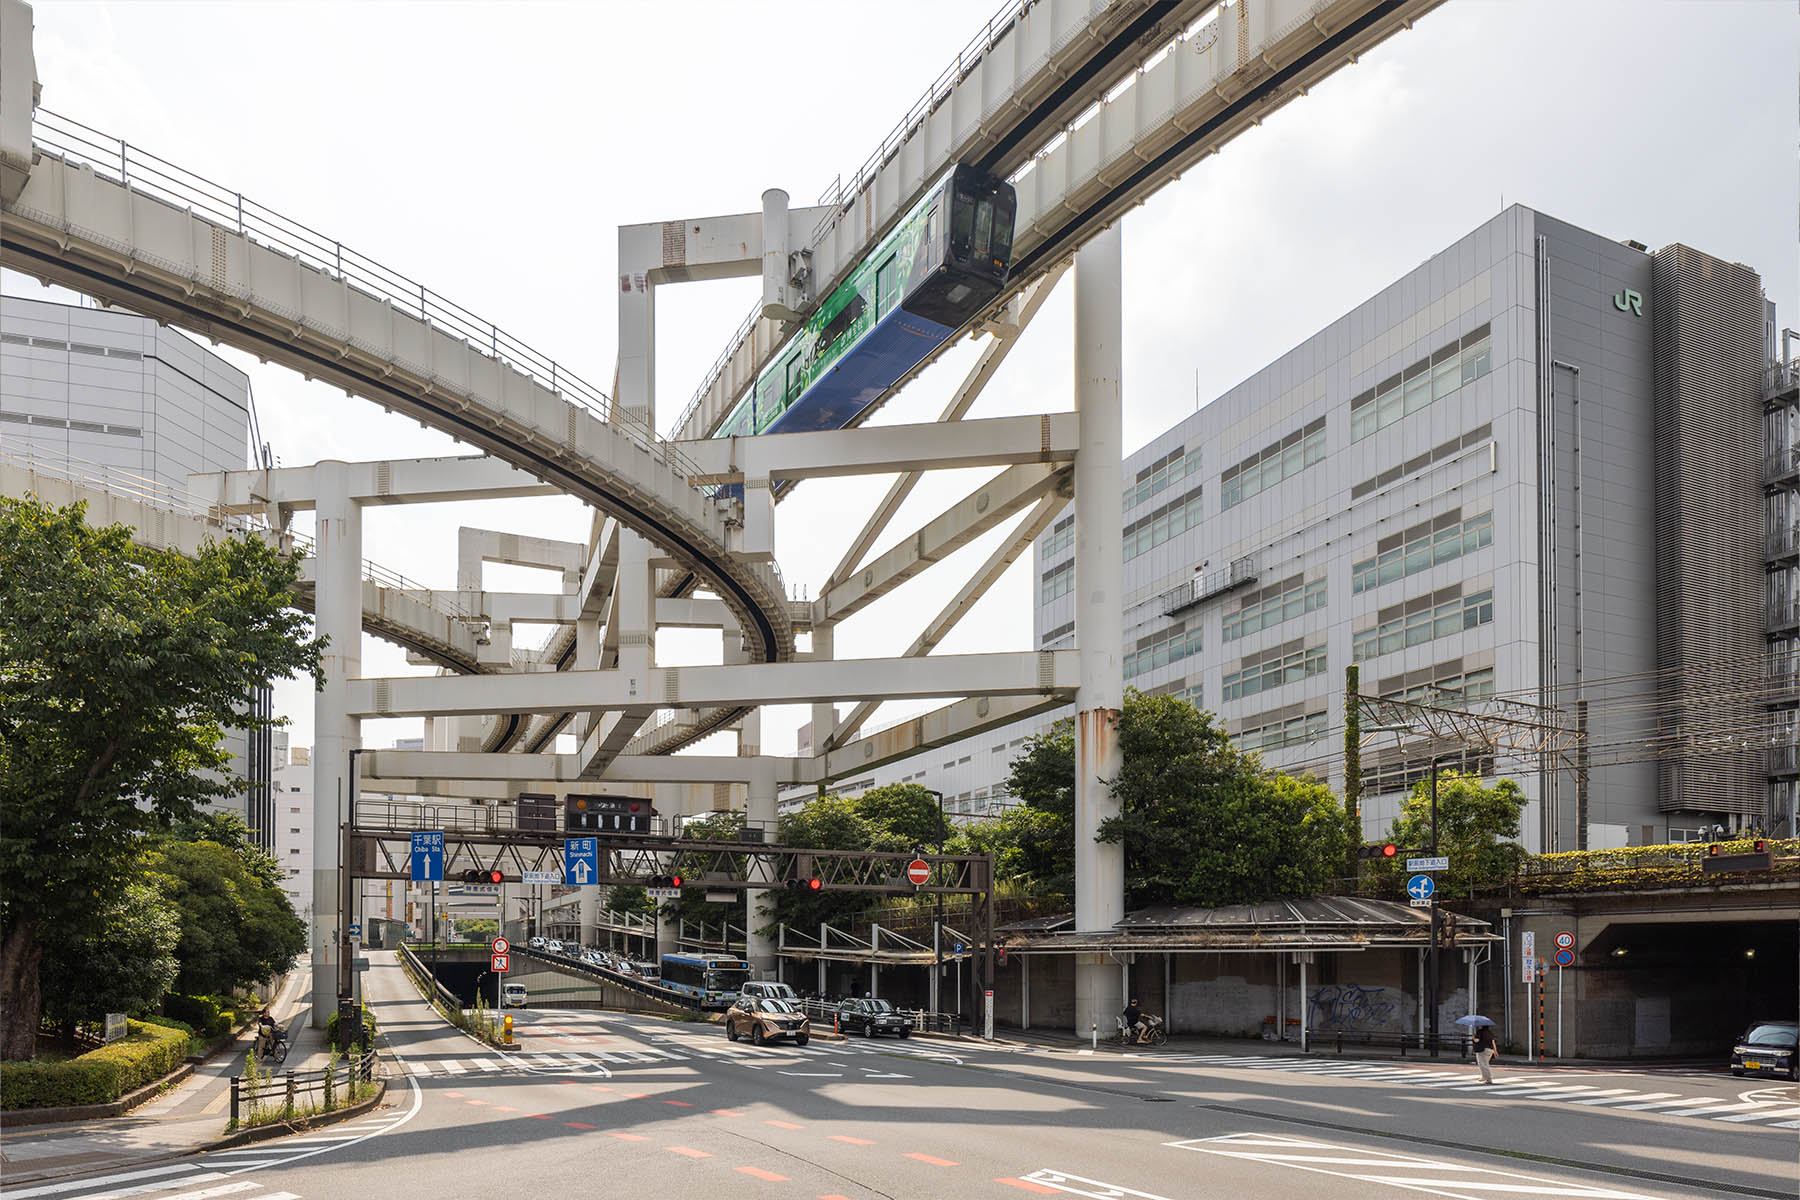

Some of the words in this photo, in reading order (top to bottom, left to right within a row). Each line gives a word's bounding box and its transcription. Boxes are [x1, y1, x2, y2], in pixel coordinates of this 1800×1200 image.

[1614, 288, 1642, 317] JR
[414, 835, 441, 845] 千葉駅
[570, 840, 592, 851] 新町
[1559, 936, 1571, 945] 40
